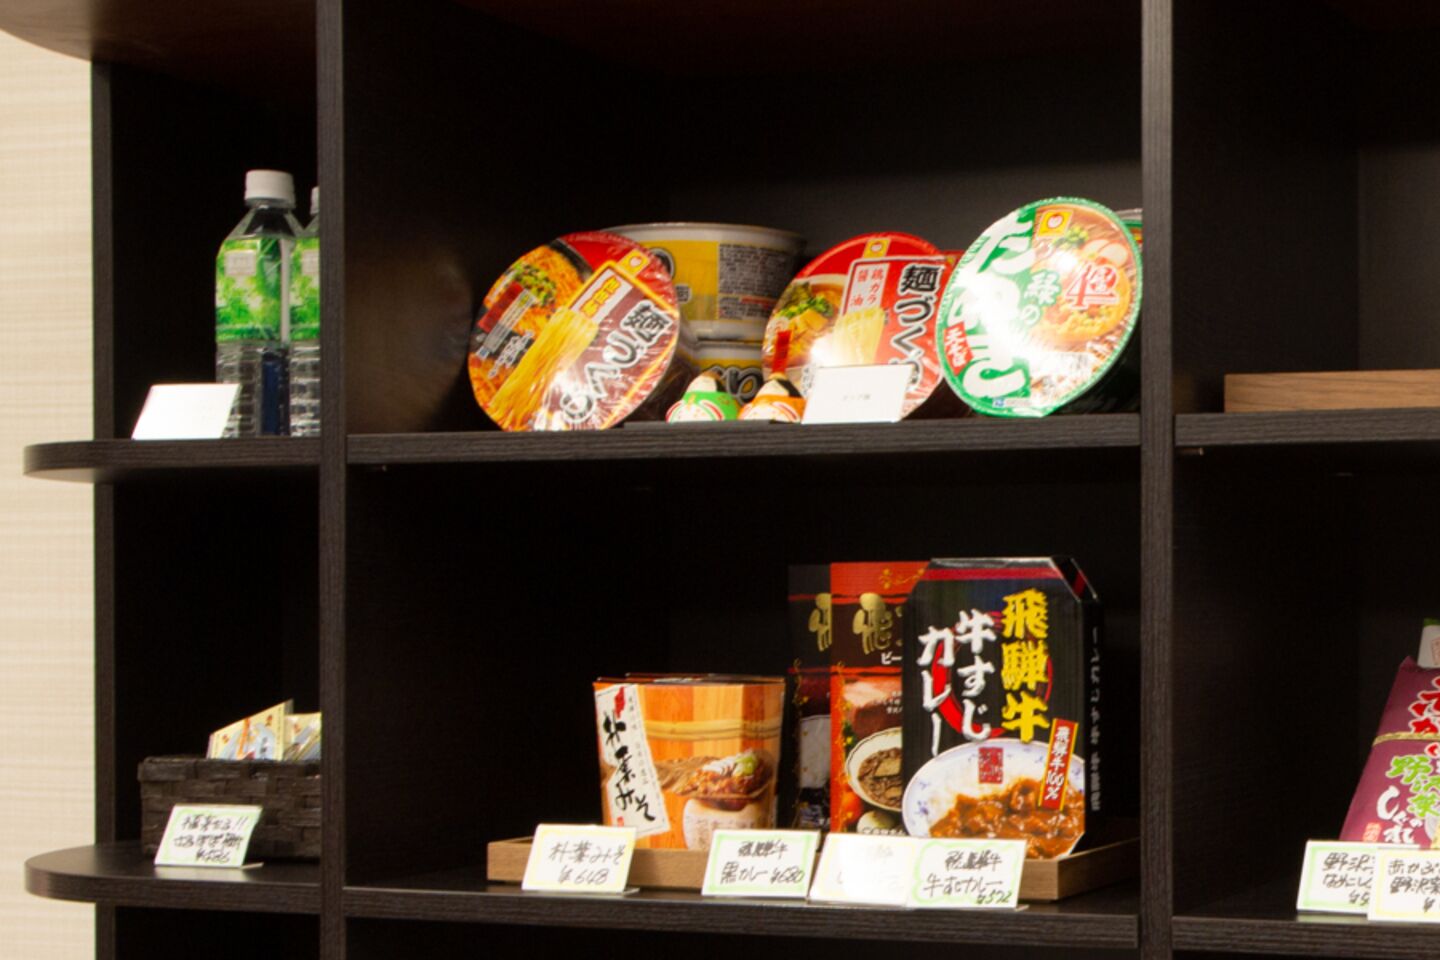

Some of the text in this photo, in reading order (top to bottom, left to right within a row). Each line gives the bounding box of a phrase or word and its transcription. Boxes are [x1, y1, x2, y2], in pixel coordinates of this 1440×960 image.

[917, 626, 956, 758] カレー
[954, 609, 997, 741] 牛すじ
[1001, 589, 1050, 744] 飛騨牛
[1323, 852, 1375, 874] 野沢
